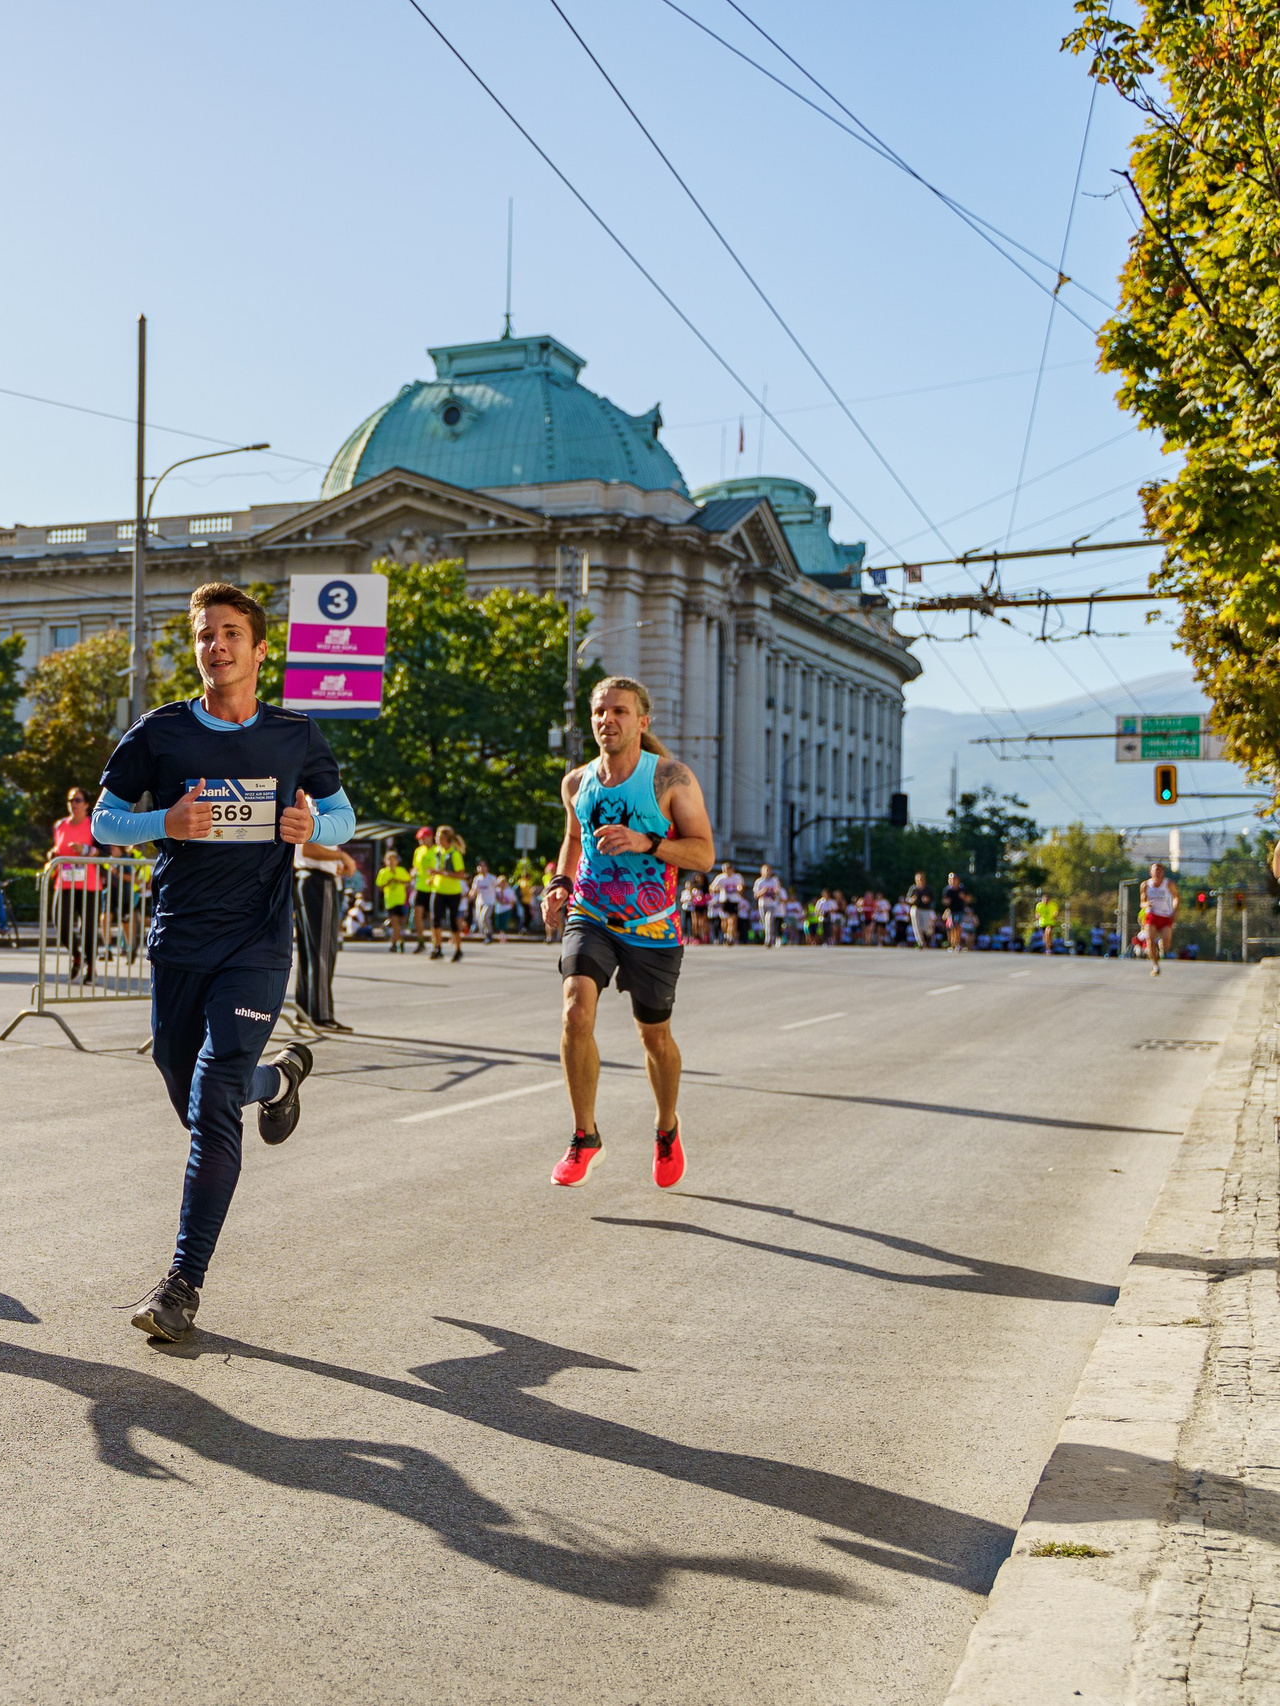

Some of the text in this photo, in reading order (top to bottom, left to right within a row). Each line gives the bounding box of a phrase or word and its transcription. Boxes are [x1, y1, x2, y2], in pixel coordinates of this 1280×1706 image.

[326, 587, 349, 614] 3
[212, 804, 252, 822] 669
[234, 1007, 271, 1022] uhlsport
